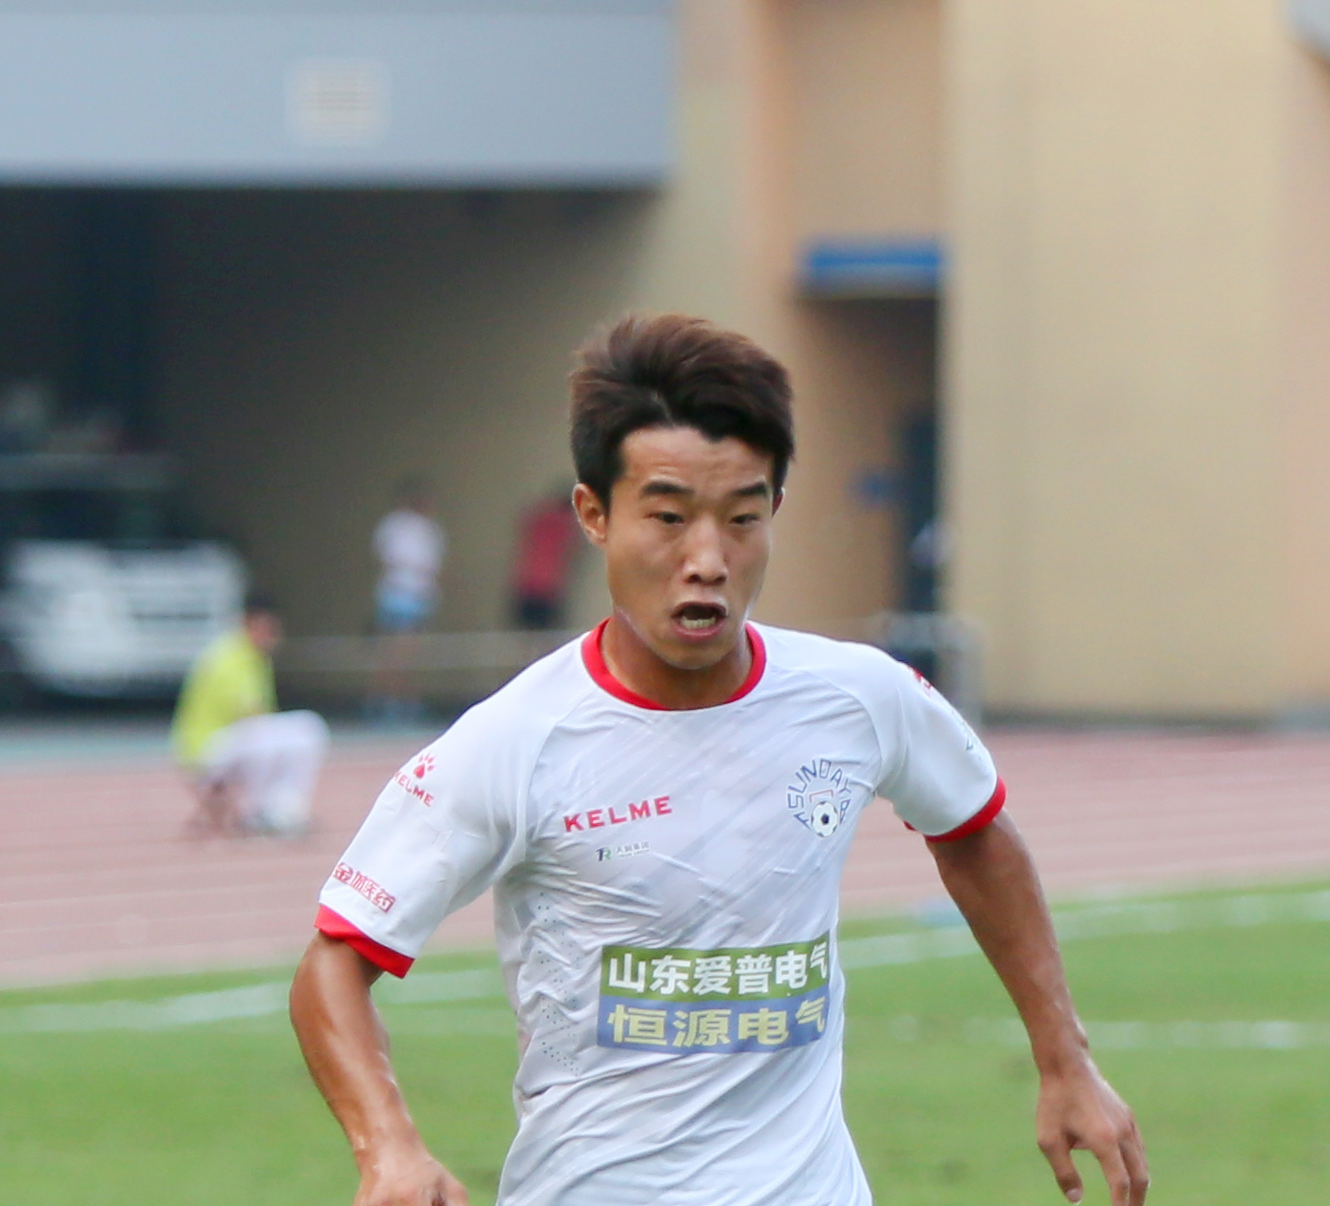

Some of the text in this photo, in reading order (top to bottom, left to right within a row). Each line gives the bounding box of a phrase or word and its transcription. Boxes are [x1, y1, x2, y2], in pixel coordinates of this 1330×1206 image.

[564, 796, 672, 832] KELME
[608, 941, 827, 994] 山东爱普电气
[607, 997, 826, 1048] 恒源电气
